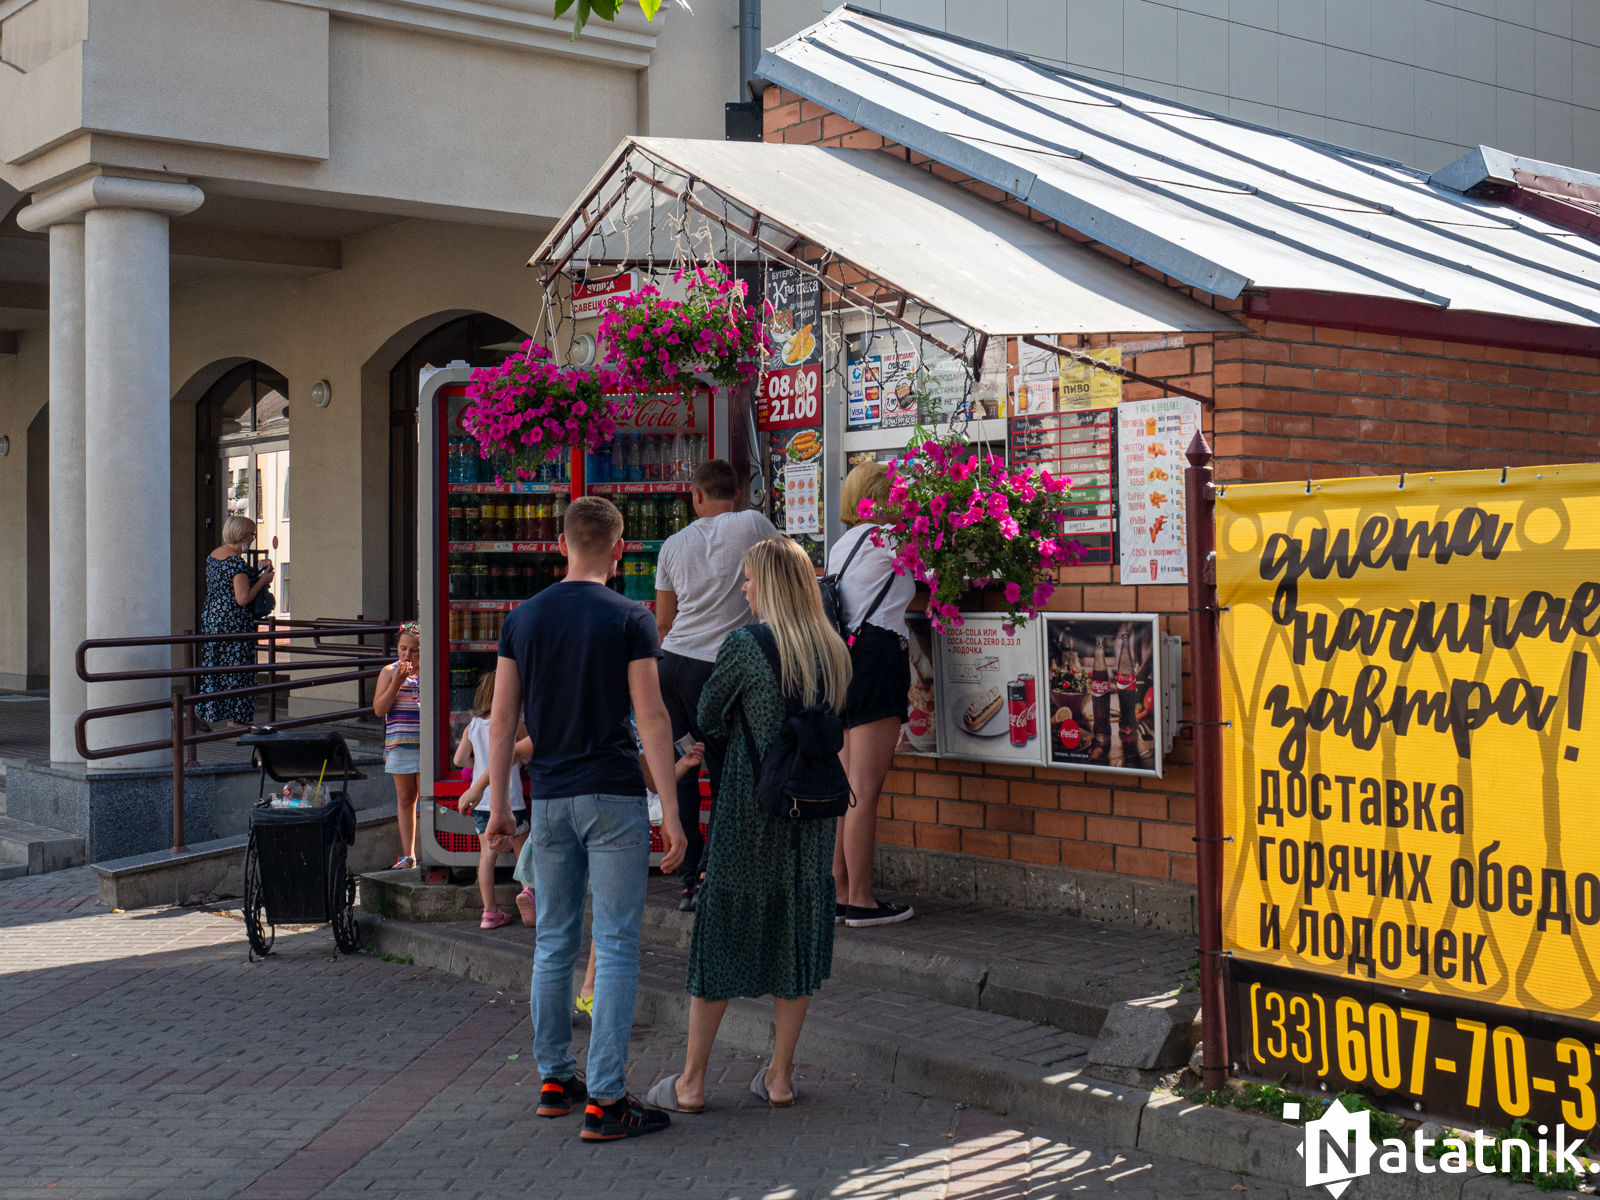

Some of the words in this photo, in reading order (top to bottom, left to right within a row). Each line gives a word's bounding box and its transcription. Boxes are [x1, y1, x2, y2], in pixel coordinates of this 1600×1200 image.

[769, 371, 817, 398] 08.00
[1063, 383, 1090, 395] ПИВО
[769, 395, 817, 422] 21.00
[852, 408, 864, 416] VISA
[1259, 507, 1513, 625] диета
[947, 628, 981, 636] COCA-COLA
[983, 629, 997, 637] ИЛИ
[947, 637, 982, 646] COCA-COLA
[983, 638, 1000, 646] ZERO
[1001, 638, 1015, 647] 0,33
[1016, 638, 1021, 646] Л
[953, 646, 983, 655] ЛОДОЧКА
[1263, 650, 1588, 773] завтра!
[1060, 728, 1079, 739] Coca-Cola
[1257, 768, 1465, 835] доставка
[1258, 835, 1433, 905] горячих
[1259, 902, 1281, 951] и
[1296, 907, 1488, 986] лодочек
[1250, 982, 1329, 1077] (33)
[1335, 996, 1600, 1132] 607-70-3
